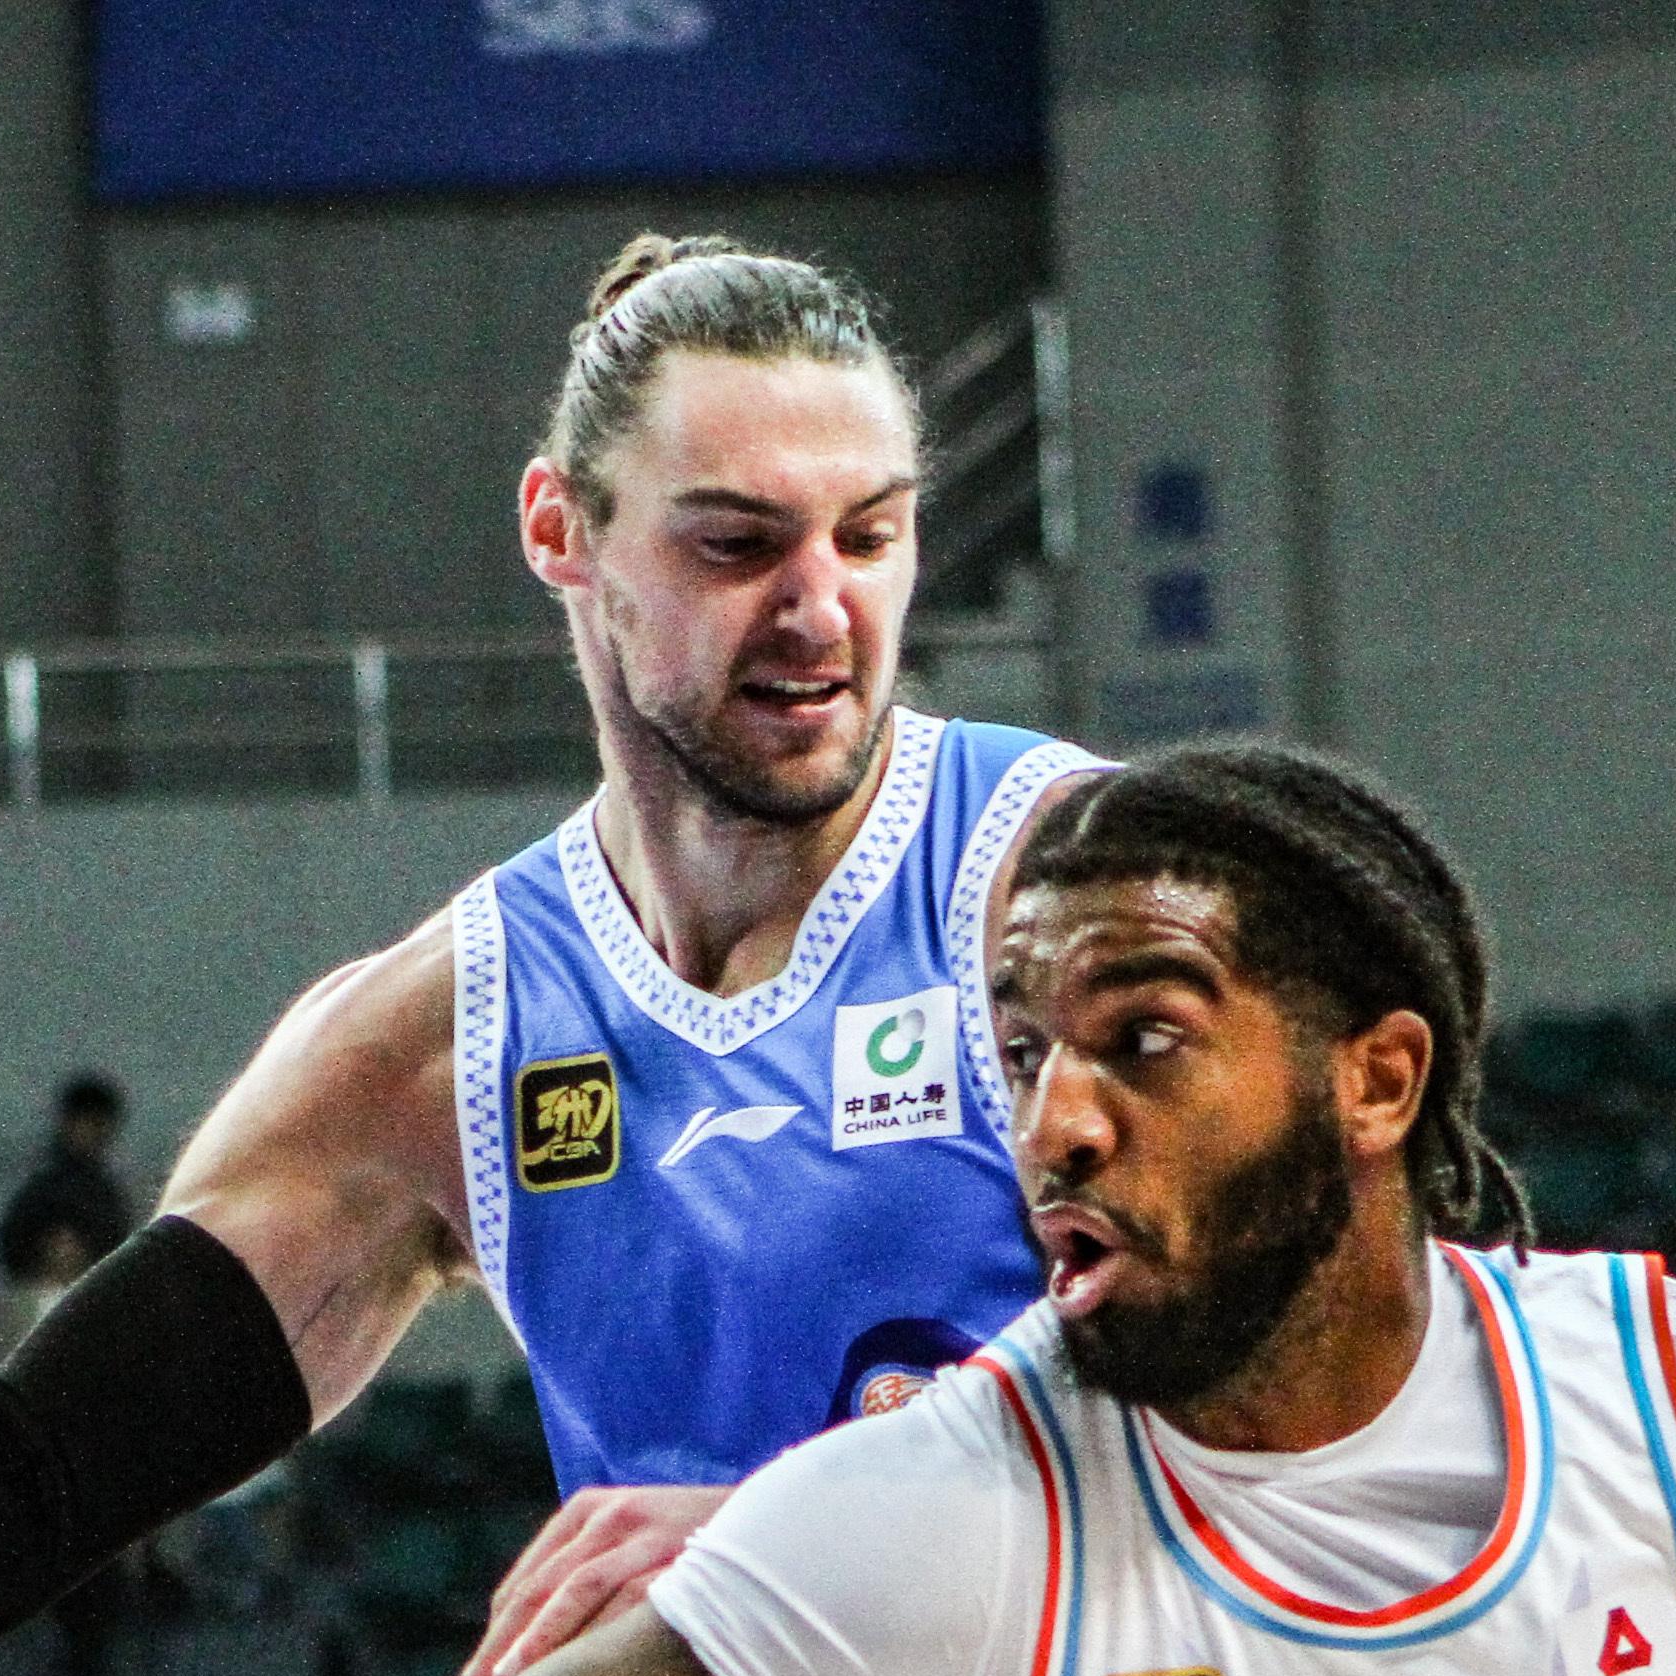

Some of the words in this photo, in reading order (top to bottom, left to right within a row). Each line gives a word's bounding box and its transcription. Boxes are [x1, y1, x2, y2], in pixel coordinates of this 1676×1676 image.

[844, 1083, 946, 1117] 中国人寿
[844, 1116, 901, 1134] CHINA
[907, 1108, 947, 1125] LIFE
